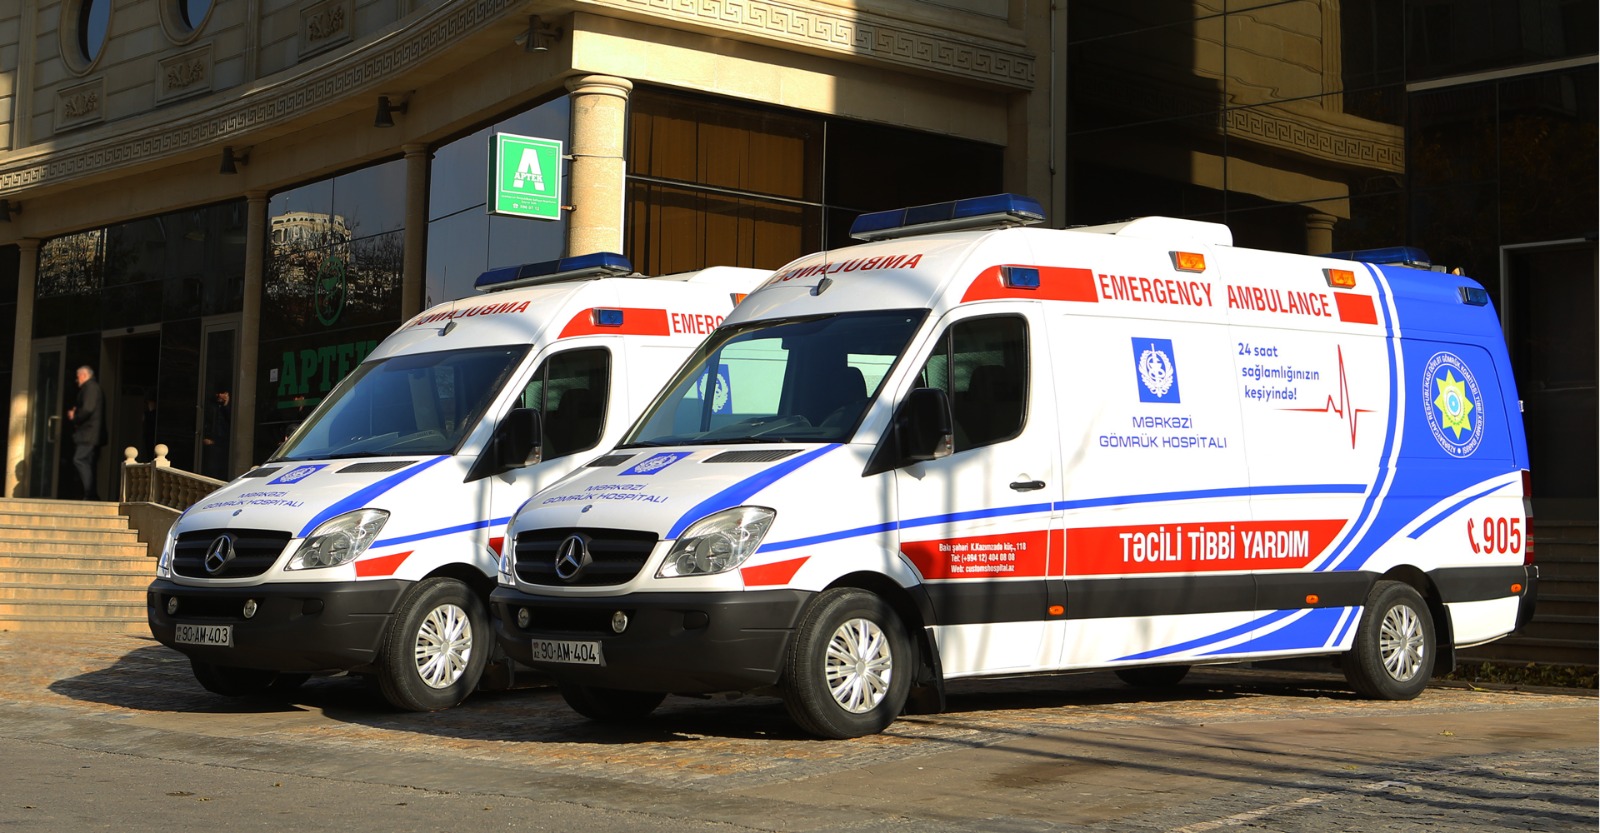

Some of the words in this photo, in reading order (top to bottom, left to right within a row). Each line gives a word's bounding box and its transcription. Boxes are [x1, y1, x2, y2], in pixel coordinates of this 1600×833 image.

[514, 172, 543, 183] APTEK
[1098, 274, 1213, 308] EMERGENCY
[1227, 284, 1332, 318] AMBULANCE
[1238, 342, 1252, 356] 24
[1253, 345, 1278, 358] saat
[1242, 364, 1320, 383] sağlamlığınızın
[1244, 385, 1297, 403] keşiyində!
[1099, 432, 1159, 448] GÖMRÜK
[1162, 433, 1227, 449] HOSPİTALI
[596, 492, 668, 504] HOSPİTALI
[1483, 516, 1521, 554] 905
[1119, 526, 1182, 563] TƏCİLİ
[1187, 525, 1235, 561] TİBBİ
[1241, 530, 1309, 559] YARDIM
[951, 553, 961, 563] Tel:
[978, 553, 988, 563] 12)
[988, 553, 999, 562] 404
[951, 564, 964, 573] Web:
